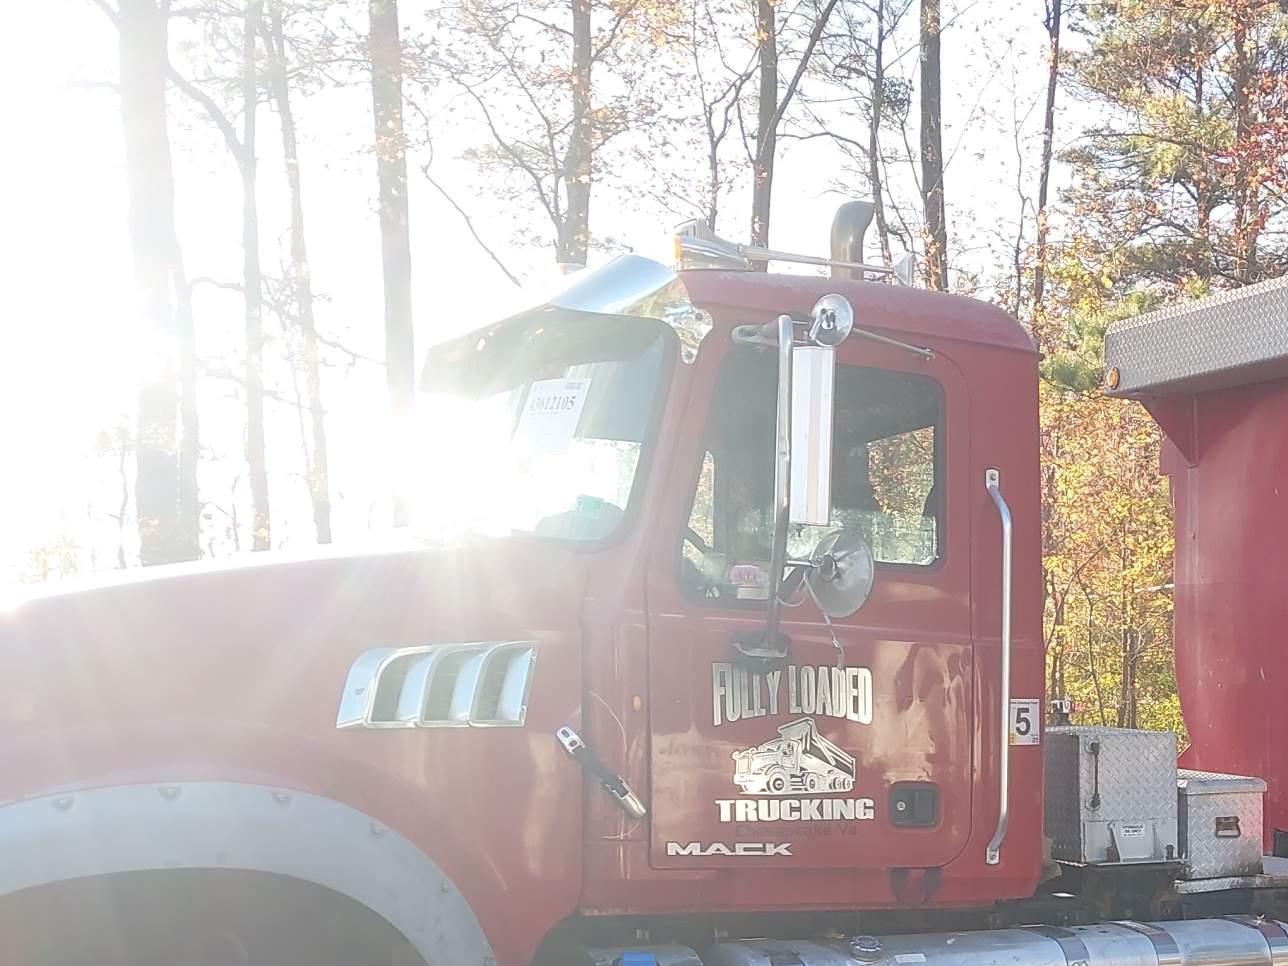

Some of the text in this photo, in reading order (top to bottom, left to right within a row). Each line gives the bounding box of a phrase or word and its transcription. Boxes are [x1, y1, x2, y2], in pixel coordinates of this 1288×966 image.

[712, 662, 873, 726] FULLY LOADED
[1015, 707, 1031, 736] 5
[715, 799, 875, 823] TRUCKING
[666, 842, 793, 857] MACK
